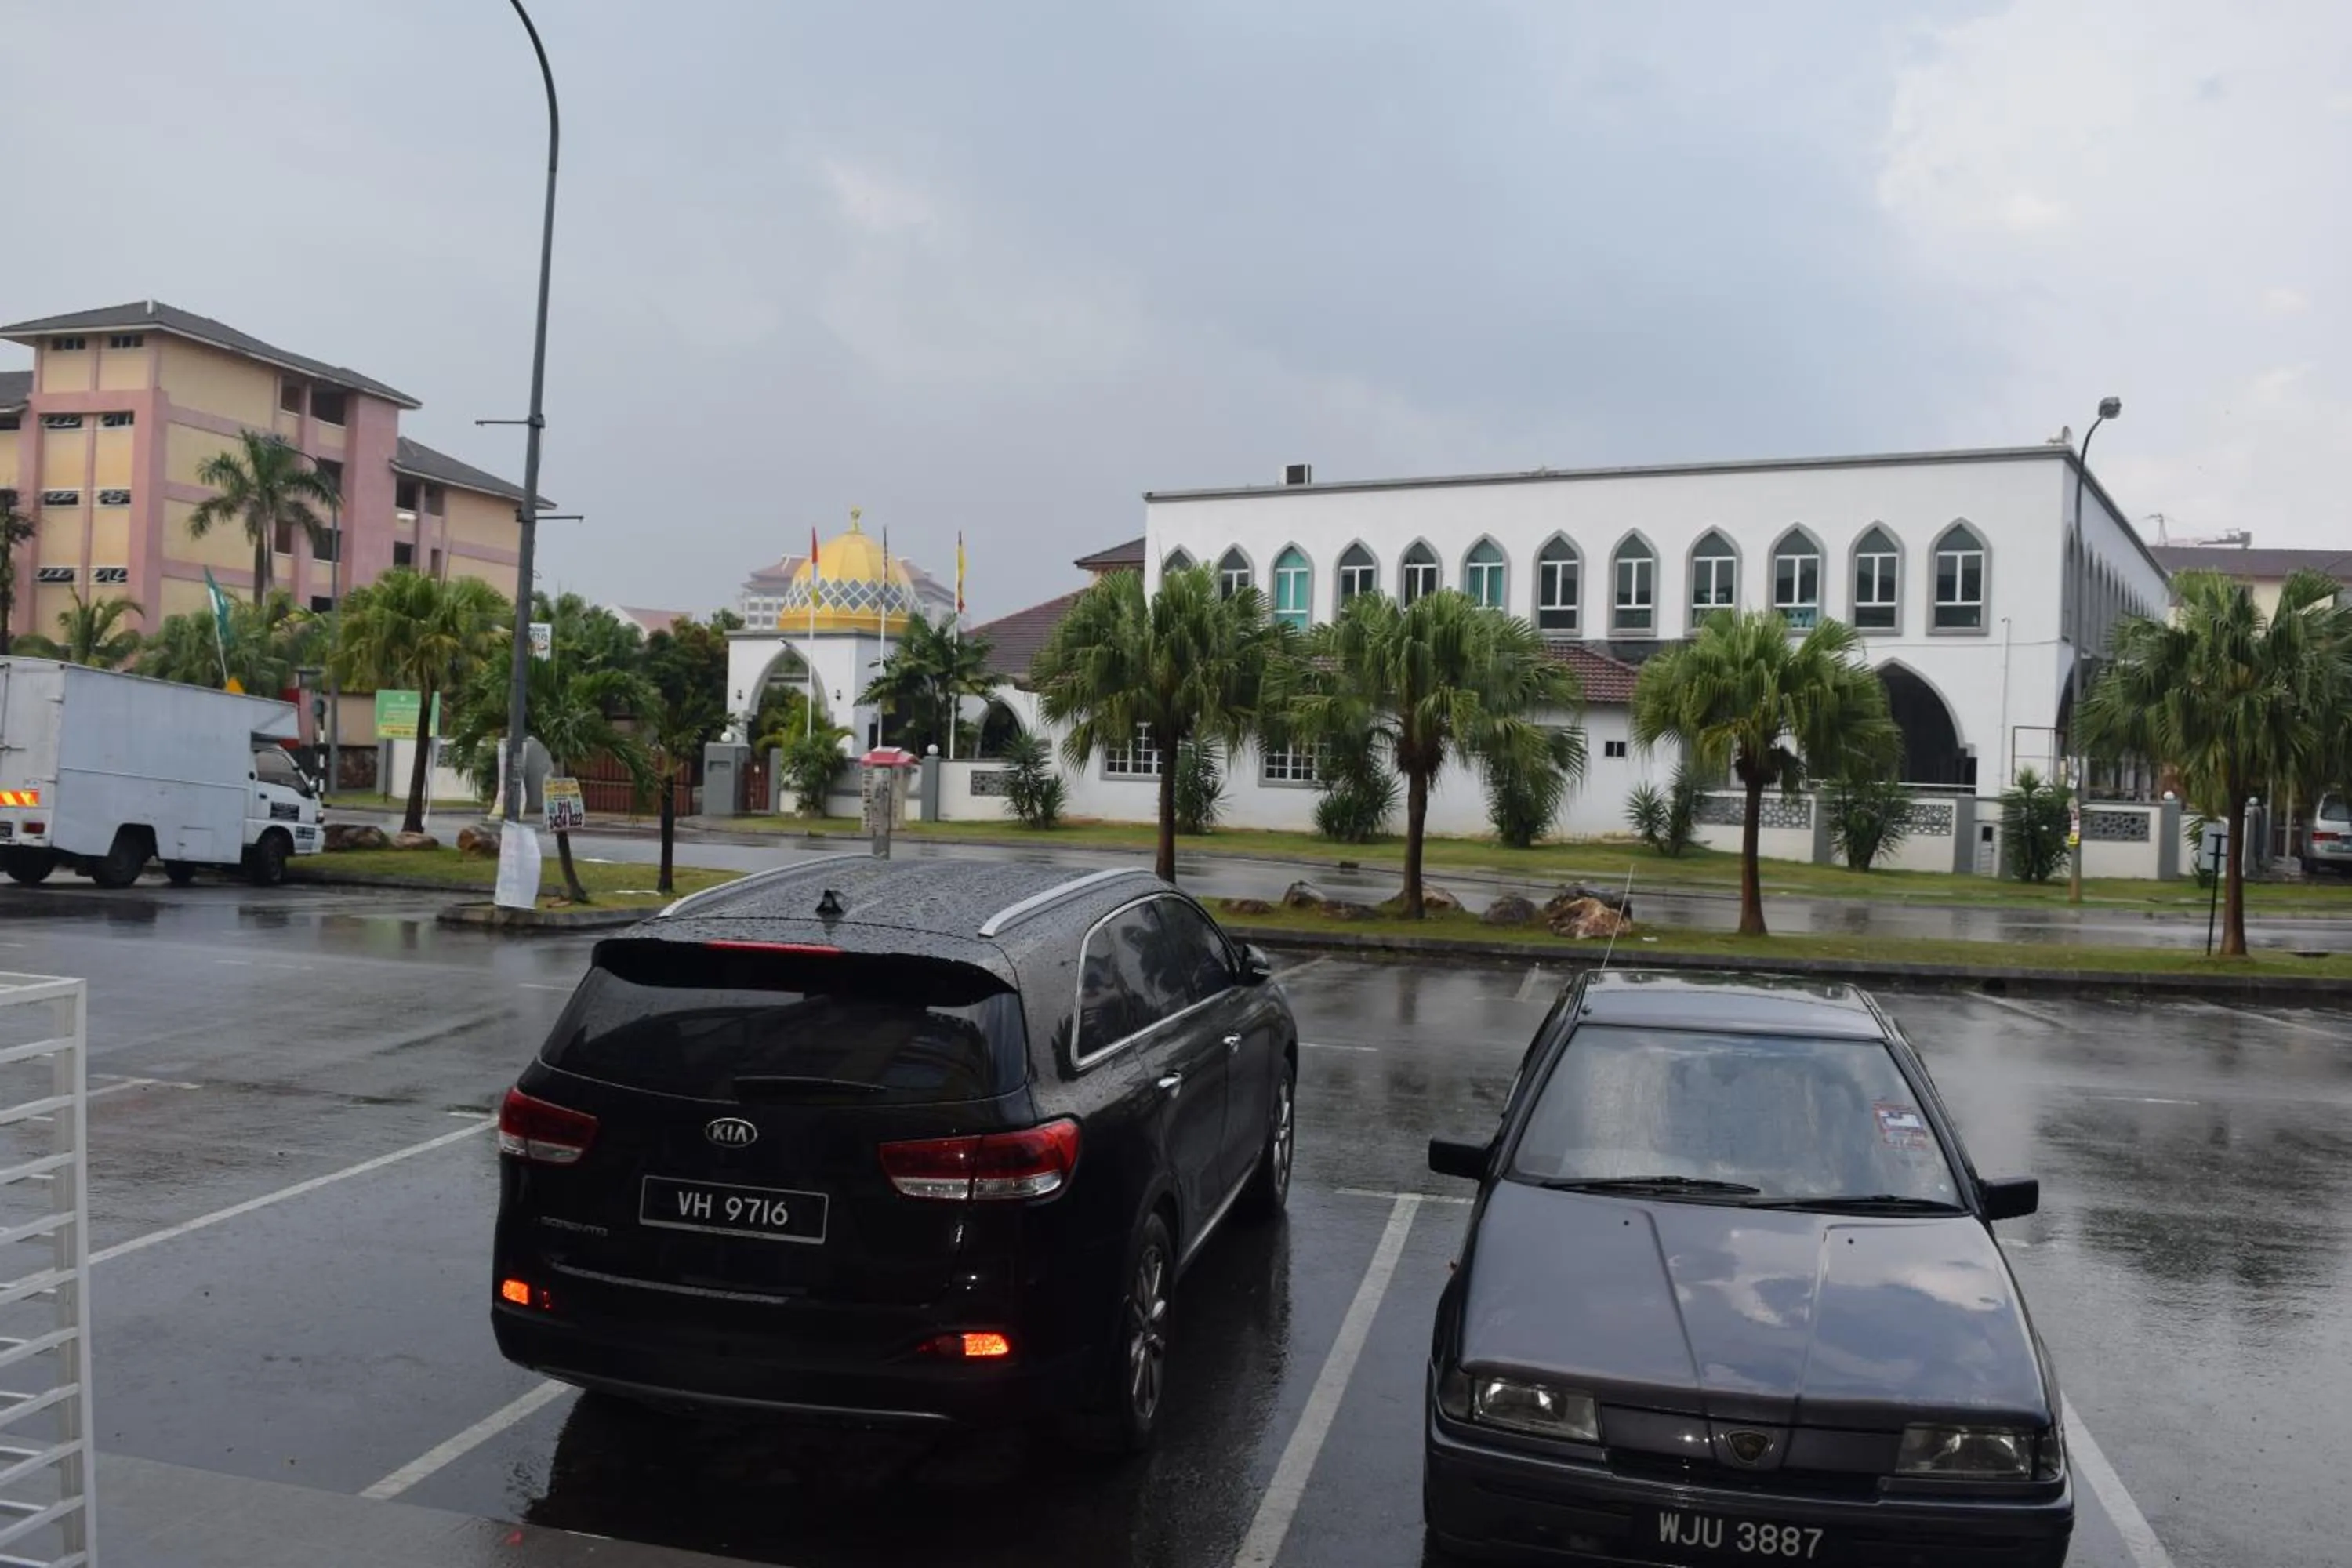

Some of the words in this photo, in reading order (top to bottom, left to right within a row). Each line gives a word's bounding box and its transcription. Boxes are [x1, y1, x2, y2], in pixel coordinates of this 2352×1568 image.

[713, 1123, 747, 1142] KIA
[677, 1191, 713, 1219] VH
[725, 1196, 789, 1226] 9716
[1659, 1512, 1723, 1549] WJU
[1737, 1522, 1824, 1559] 3887
